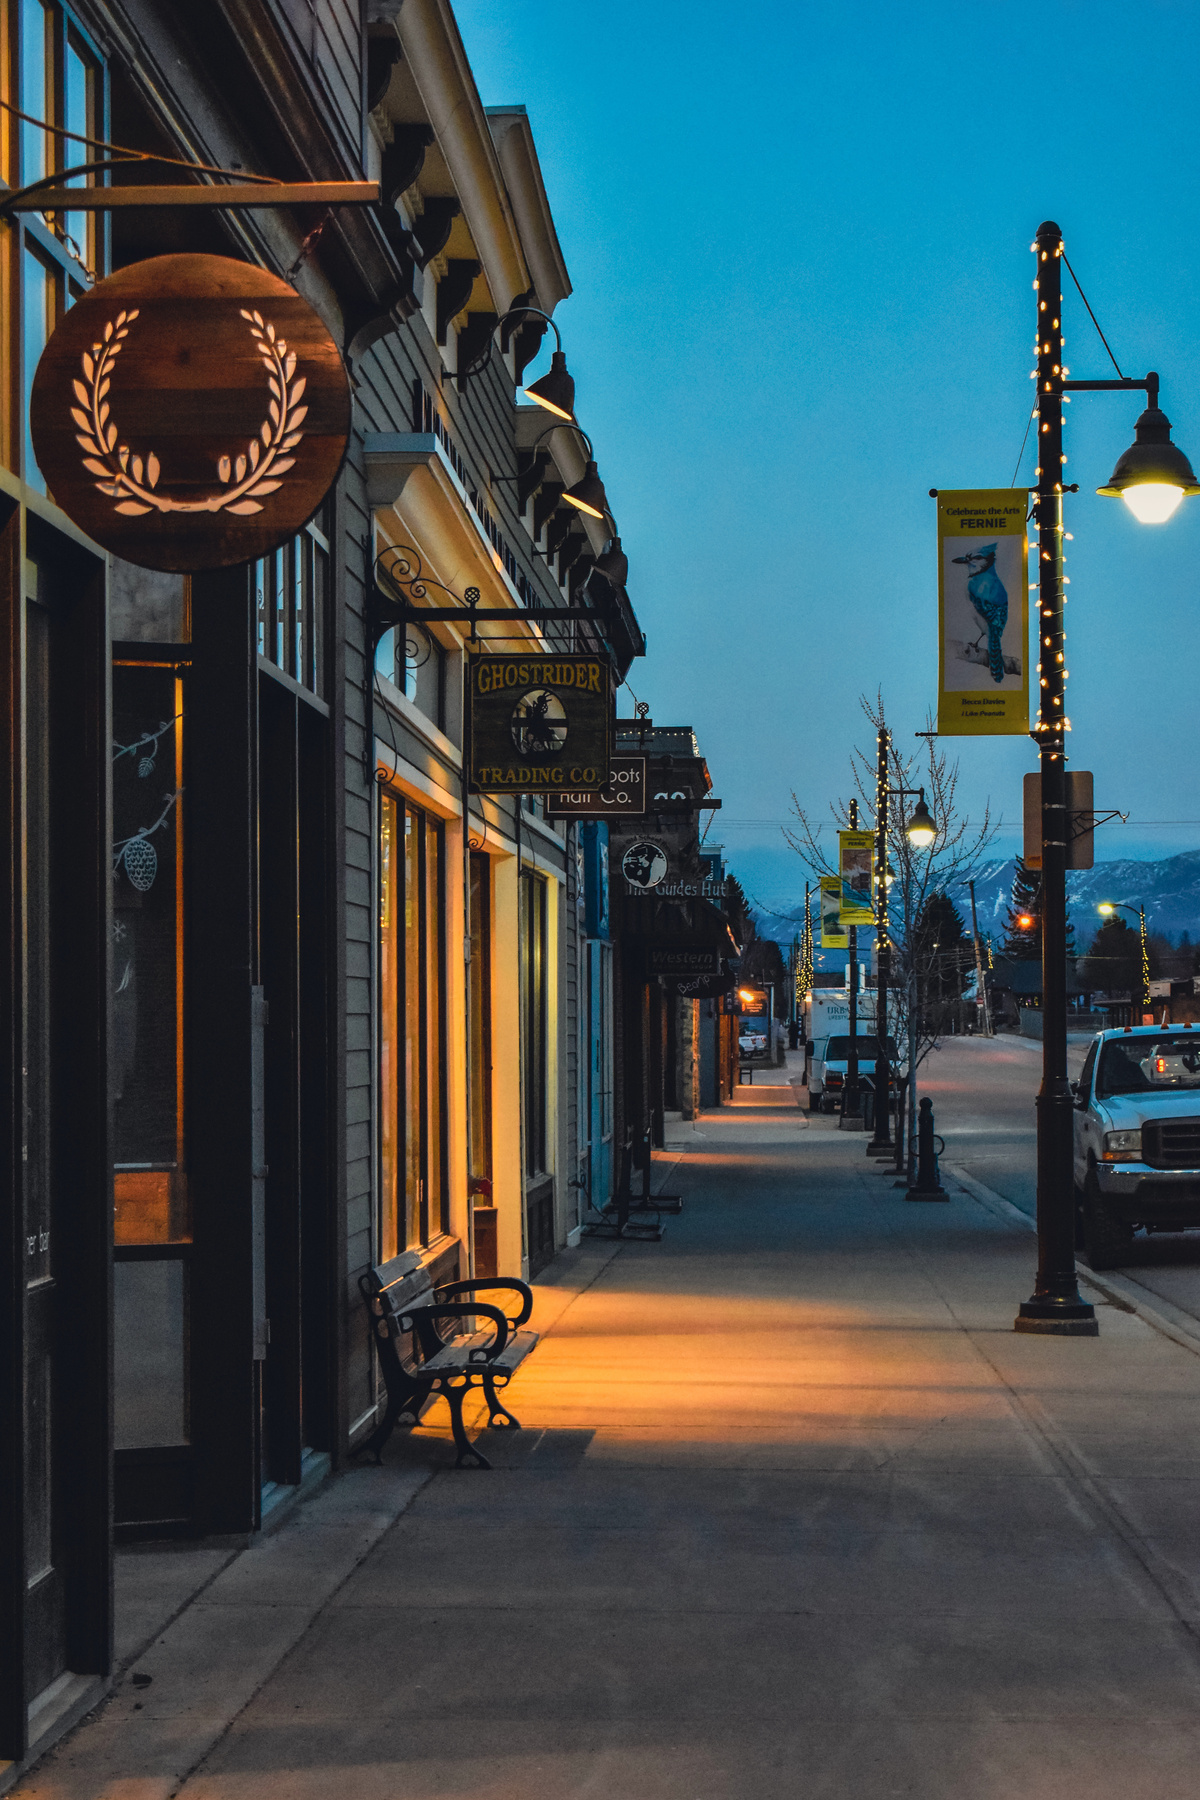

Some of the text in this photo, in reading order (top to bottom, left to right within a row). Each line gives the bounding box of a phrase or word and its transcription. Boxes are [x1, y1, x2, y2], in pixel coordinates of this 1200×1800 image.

[946, 506, 1020, 516] Celebrate the Arts
[960, 518, 1007, 528] FERNIE
[478, 664, 601, 694] GHOSTRIDER
[478, 768, 601, 784] TRADING CO.
[600, 786, 632, 804] Co.
[655, 880, 698, 897] Guides
[700, 881, 727, 898] Hut
[652, 951, 713, 963] Western
